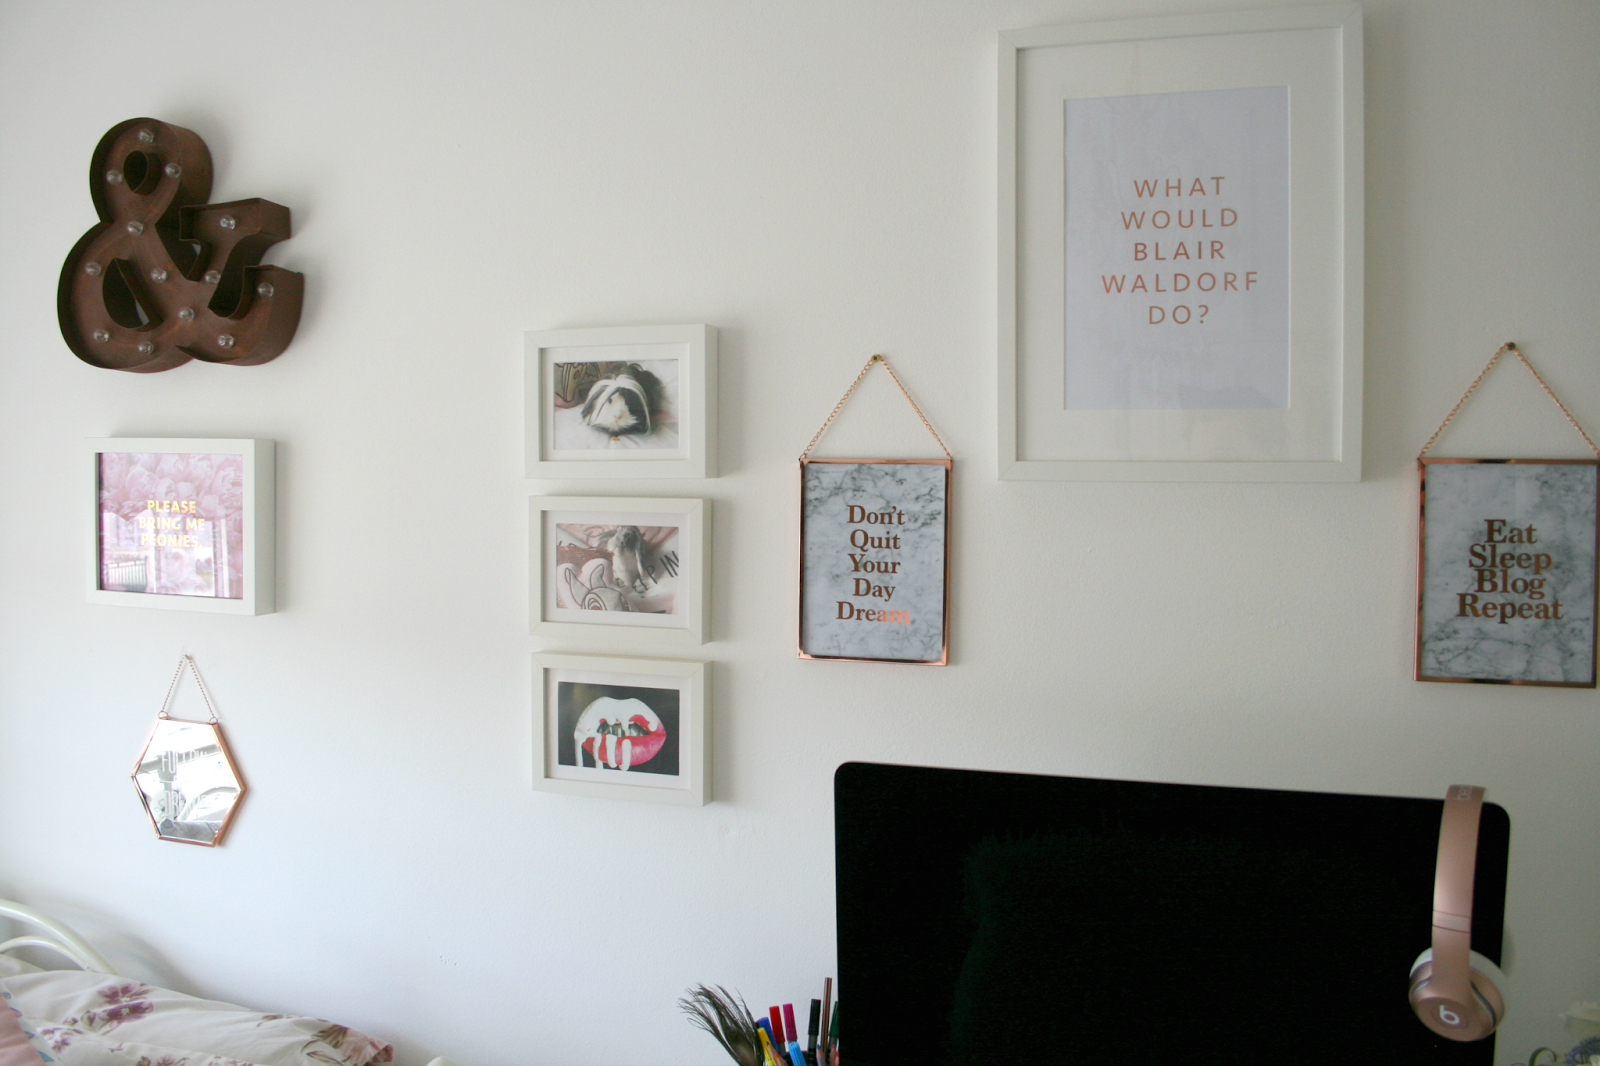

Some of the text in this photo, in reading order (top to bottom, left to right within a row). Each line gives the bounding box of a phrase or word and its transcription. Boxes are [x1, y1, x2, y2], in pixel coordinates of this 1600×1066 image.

[1133, 176, 1225, 199] WHAT
[1120, 208, 1238, 230] WOULD
[57, 117, 304, 374] &
[1134, 240, 1225, 262] BLAIR
[1101, 271, 1258, 294] WALDORF
[1148, 304, 1209, 325] DO?
[147, 499, 197, 514] PLEASE
[846, 504, 906, 526] Don't
[138, 516, 206, 531] BRING ME
[1483, 518, 1538, 544] Eat
[140, 534, 203, 548] PEONIES.
[850, 529, 901, 552] Quit
[847, 553, 902, 574] Your
[1468, 543, 1552, 576] Sleep
[852, 577, 896, 602] Day
[1474, 568, 1547, 600] Blog
[835, 600, 911, 624] Dream
[1455, 592, 1564, 625] Repeat
[160, 749, 208, 774] FOO
